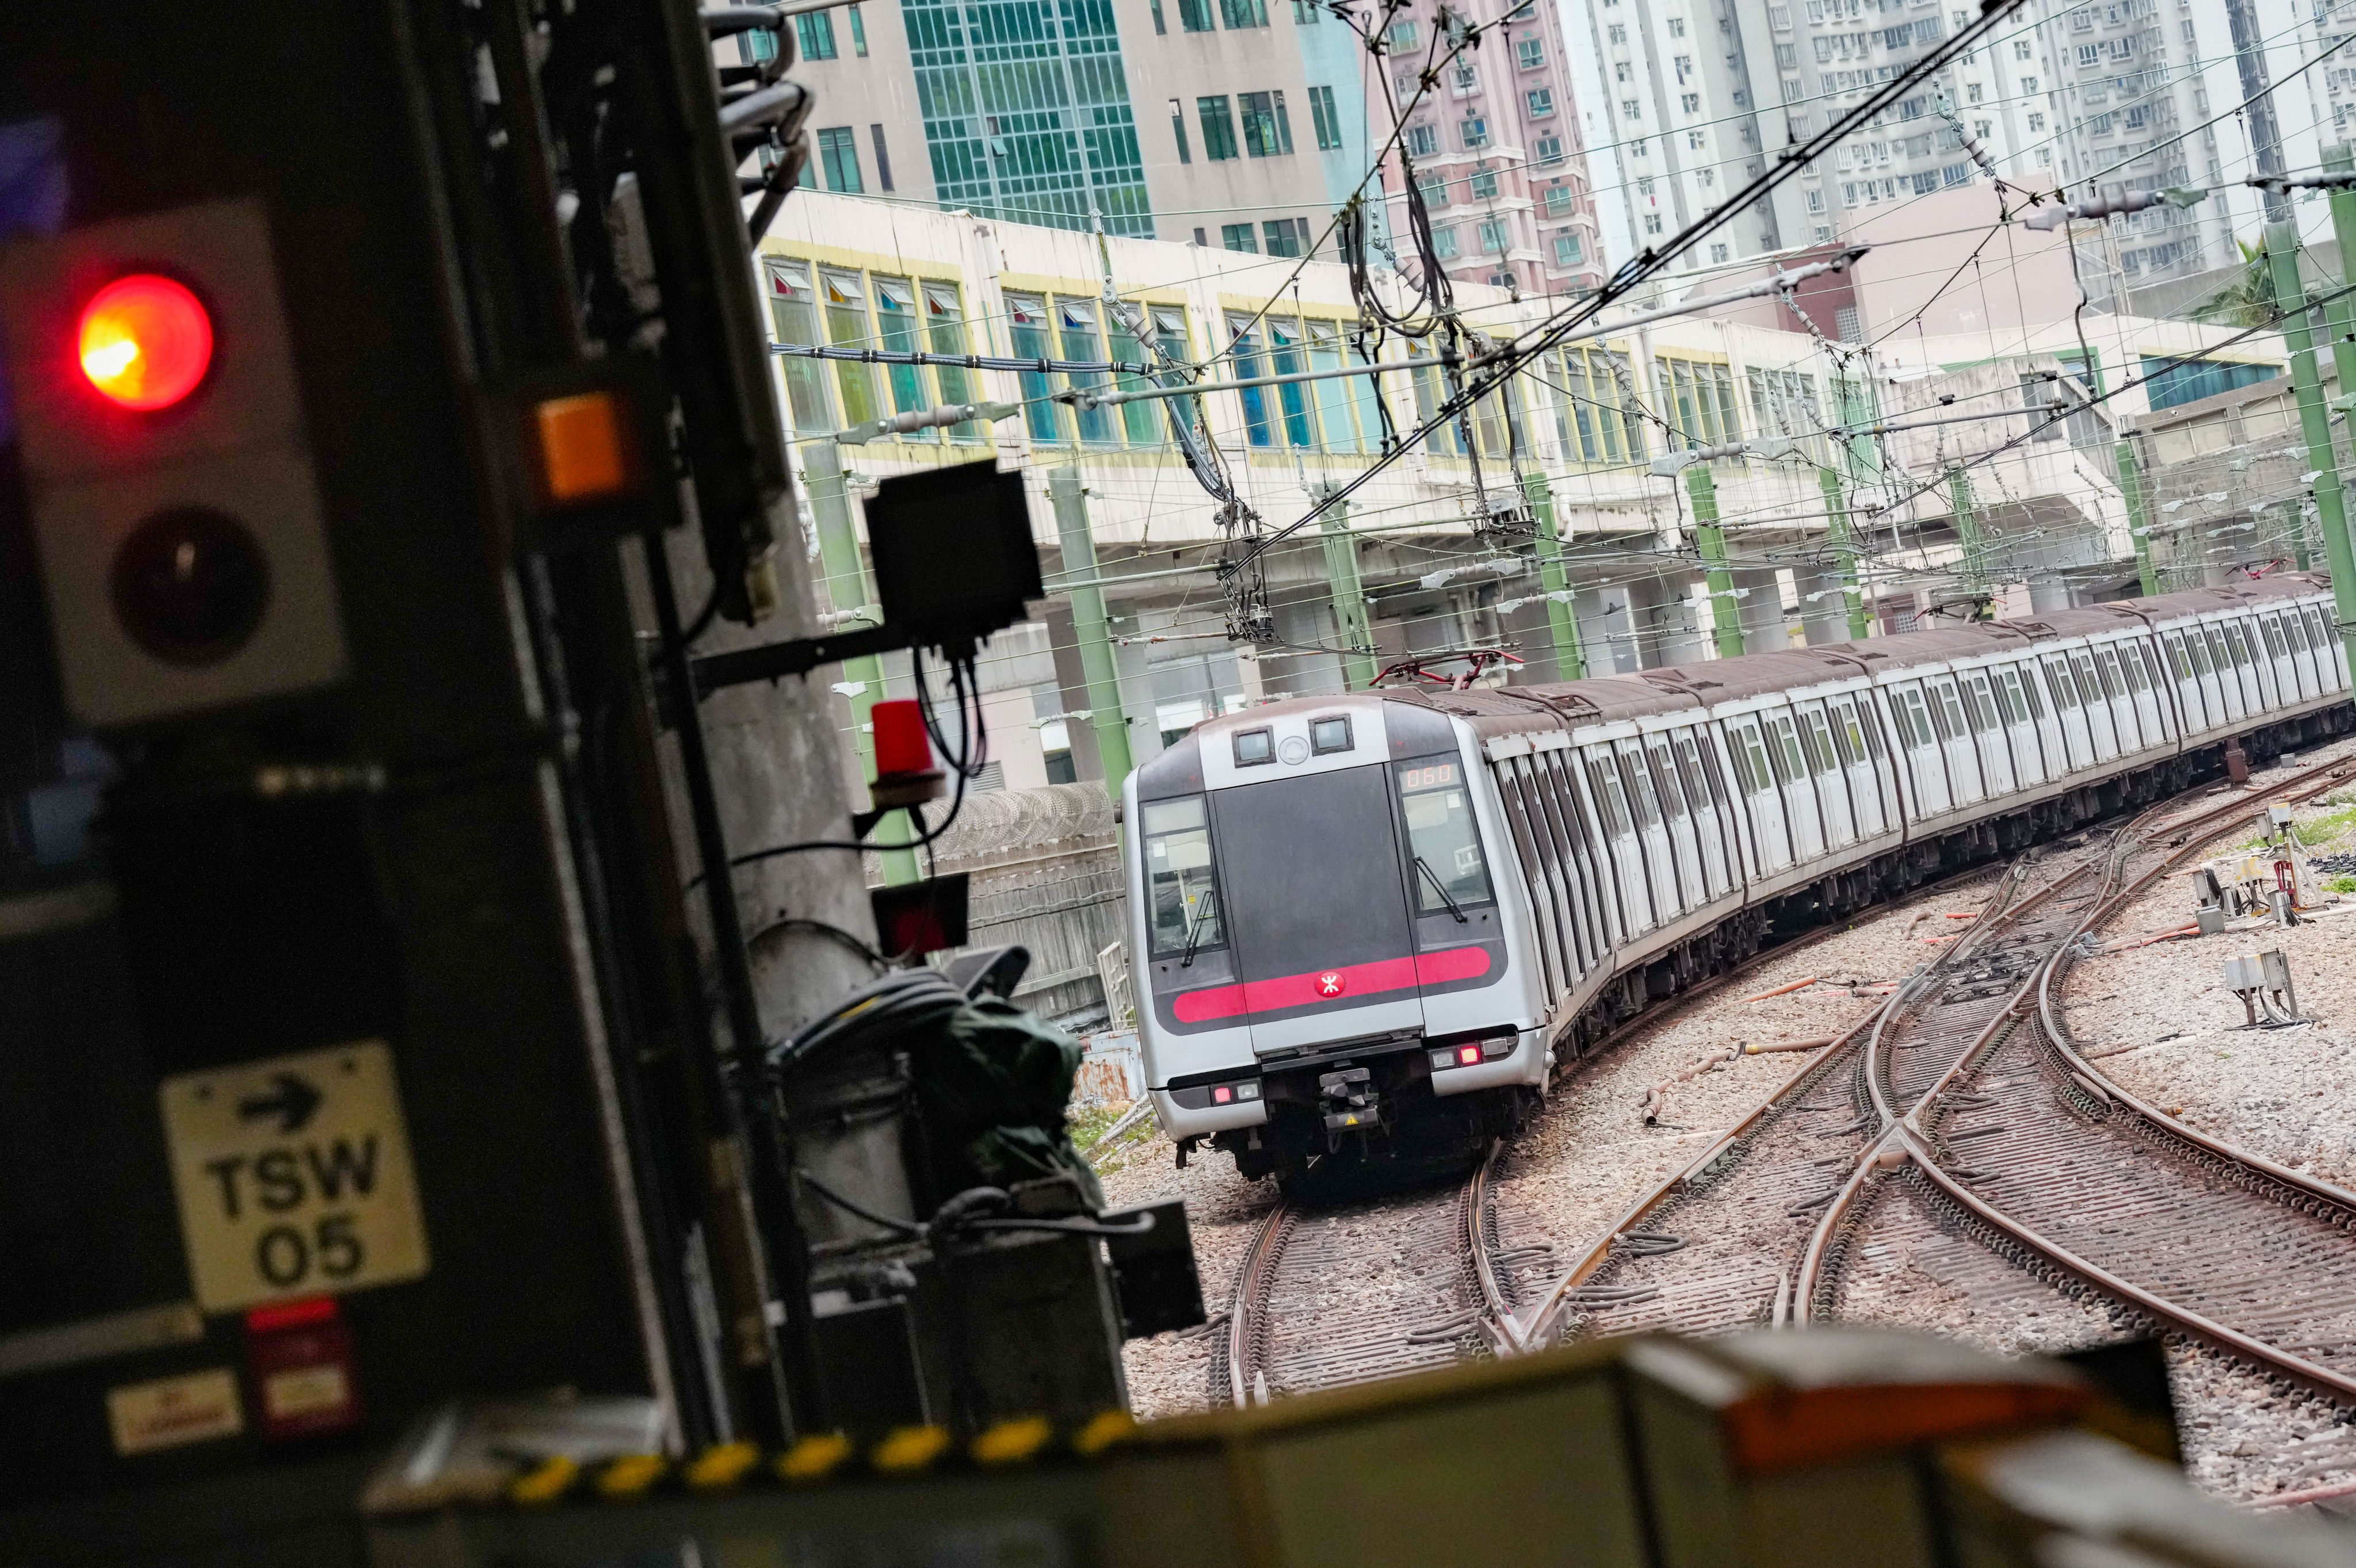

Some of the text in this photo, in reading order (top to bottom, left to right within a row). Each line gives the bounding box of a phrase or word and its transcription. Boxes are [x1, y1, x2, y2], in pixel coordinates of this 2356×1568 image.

[1408, 764, 1450, 787] 060
[205, 1133, 377, 1222] TSW
[256, 1214, 364, 1287] 05
